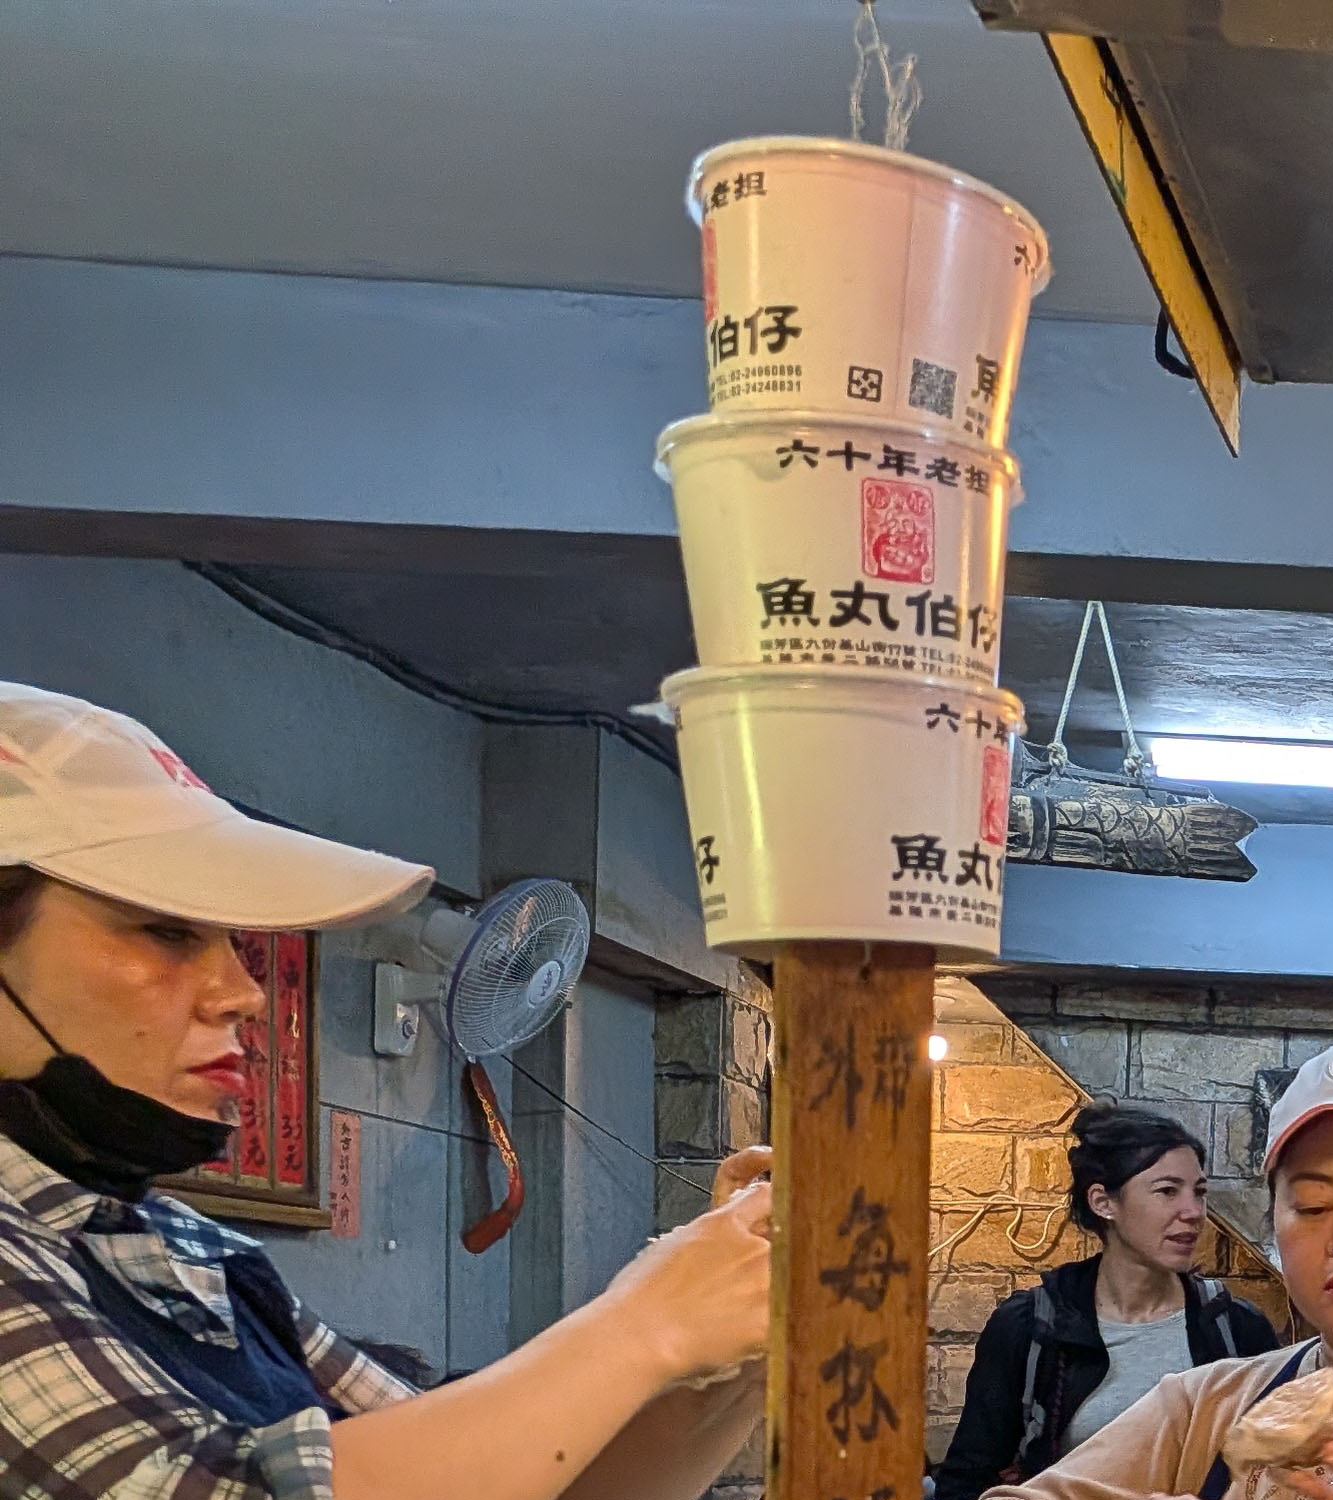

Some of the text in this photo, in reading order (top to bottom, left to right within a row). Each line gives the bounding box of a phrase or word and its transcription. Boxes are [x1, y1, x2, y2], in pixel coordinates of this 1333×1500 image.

[703, 171, 767, 214] 老担
[756, 577, 998, 654] 魚丸伯仔
[891, 832, 1002, 896] 魚丸
